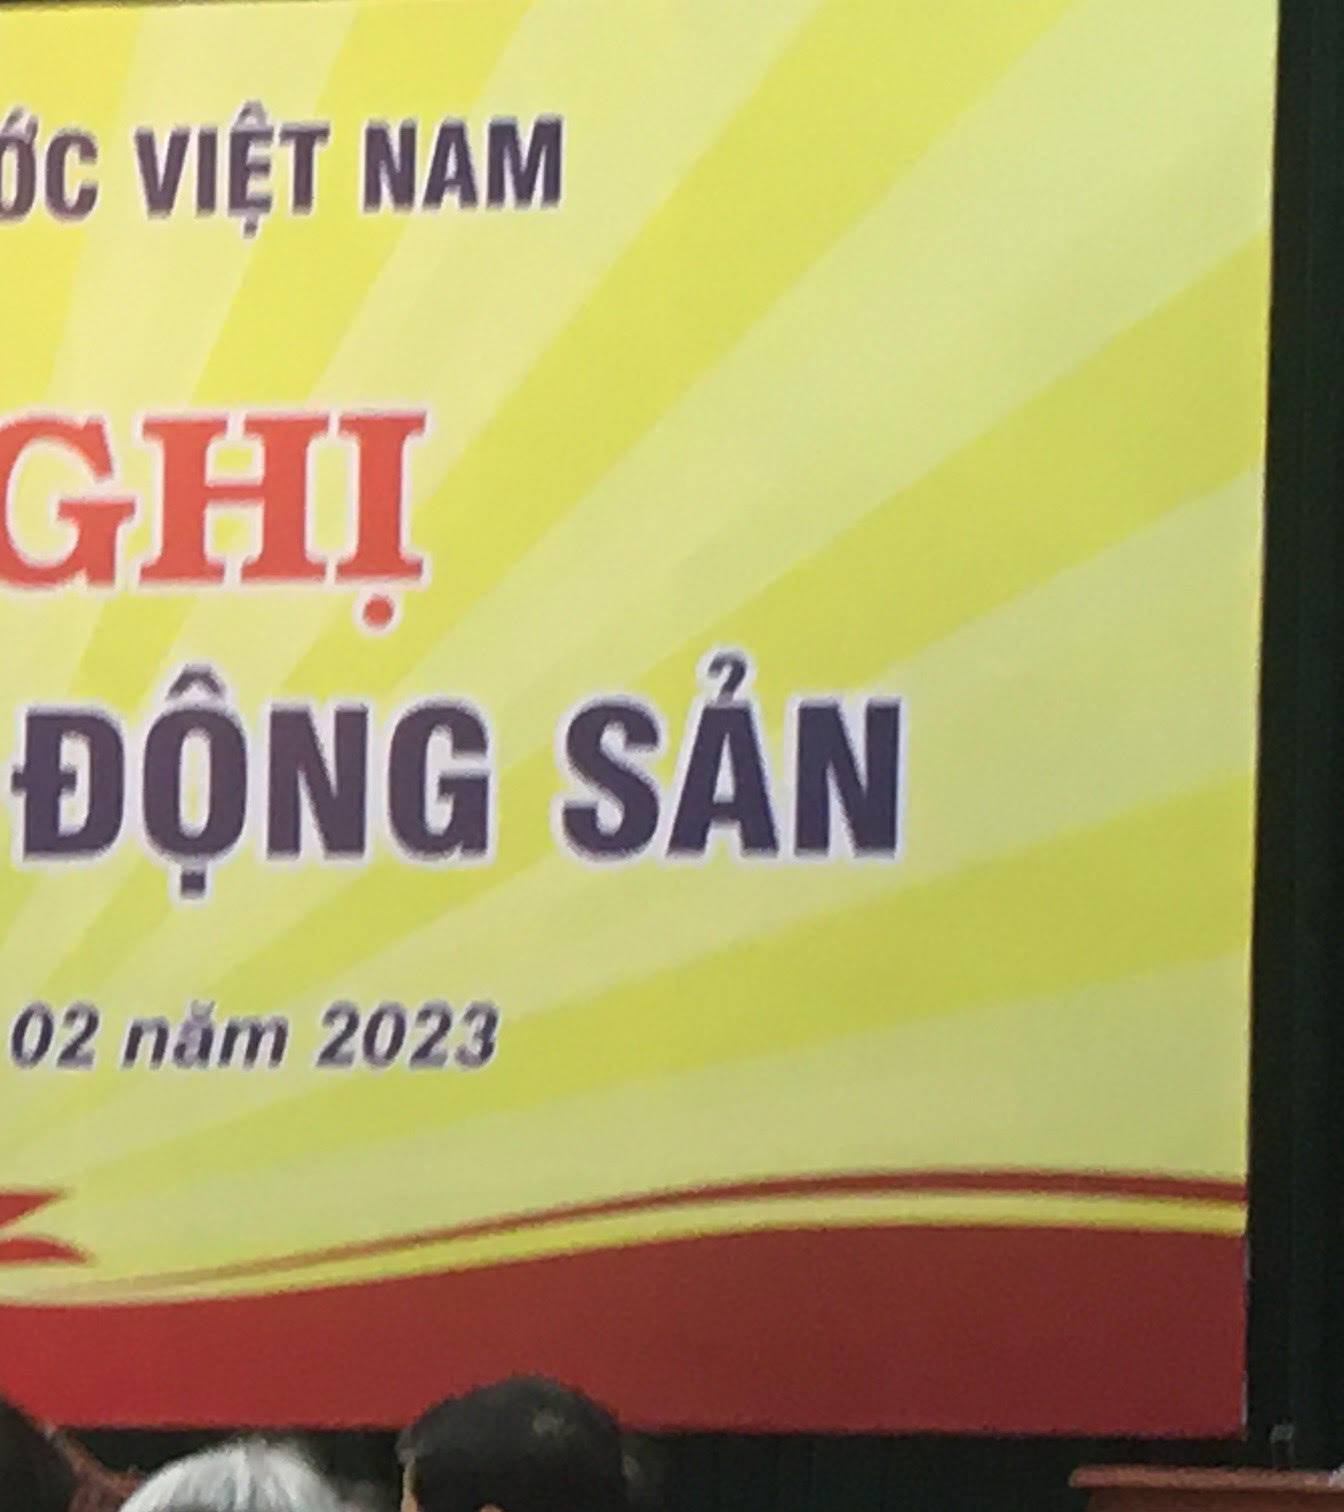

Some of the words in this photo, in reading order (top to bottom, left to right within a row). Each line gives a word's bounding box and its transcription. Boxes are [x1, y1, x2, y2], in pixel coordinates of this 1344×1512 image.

[134, 101, 330, 238] VIỆT
[363, 115, 562, 213] NAM
[11, 665, 491, 899] ĐỘNG
[561, 652, 901, 862] SẢN
[10, 1001, 100, 1069] 02
[122, 1000, 289, 1069] năm
[315, 1001, 499, 1070] 2023
